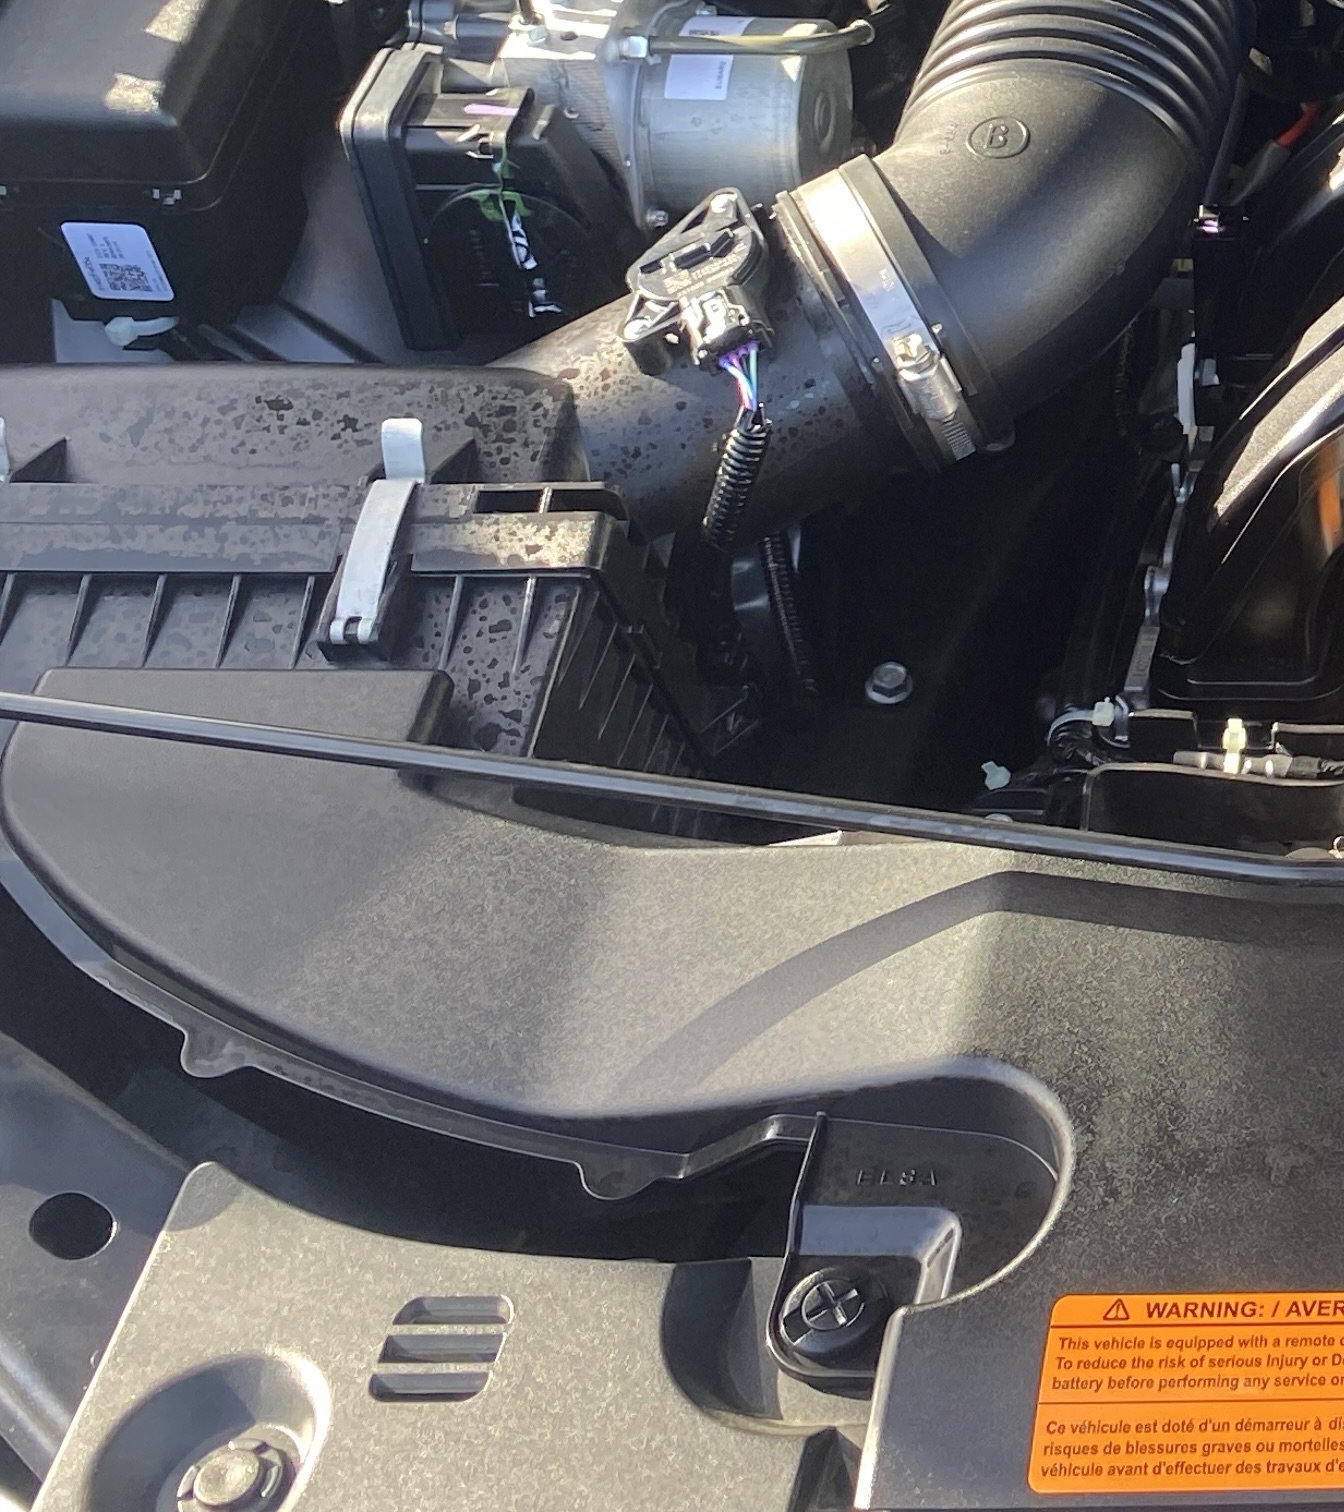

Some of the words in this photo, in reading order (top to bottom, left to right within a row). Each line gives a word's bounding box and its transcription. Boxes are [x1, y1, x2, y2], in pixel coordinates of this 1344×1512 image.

[1146, 1301, 1265, 1319] WARNING:
[1271, 1300, 1281, 1319] /
[1058, 1336, 1090, 1351] This
[1094, 1336, 1145, 1350] vehicle
[1149, 1336, 1162, 1349] is
[1166, 1335, 1234, 1352] equipped
[1238, 1335, 1268, 1348] with
[1272, 1337, 1281, 1348] a
[1284, 1336, 1337, 1347] remote
[1055, 1356, 1073, 1370] To
[1076, 1355, 1128, 1370] reduce
[1130, 1355, 1155, 1369] the
[1158, 1355, 1186, 1369] risk
[1189, 1354, 1205, 1368] of
[1207, 1354, 1262, 1368] serious
[1311, 1355, 1329, 1366] or
[1051, 1376, 1103, 1393] battery
[1107, 1375, 1154, 1389] before
[1157, 1374, 1240, 1392] performing
[1242, 1377, 1270, 1391] any
[1273, 1373, 1326, 1387] service
[1045, 1419, 1066, 1435] Ce
[1070, 1419, 1132, 1434] véhicule
[1134, 1420, 1158, 1433] est
[1161, 1418, 1194, 1433] doté
[1198, 1418, 1231, 1432] d'un
[1234, 1417, 1311, 1432] démarreur
[1313, 1416, 1323, 1430] à
[1042, 1441, 1099, 1458] risques
[1102, 1441, 1122, 1455] de
[1125, 1440, 1198, 1455] blessures
[1201, 1442, 1252, 1457] graves
[1255, 1442, 1275, 1453] ou
[1040, 1462, 1104, 1477] véhicule
[1106, 1463, 1149, 1477] avant
[1152, 1461, 1231, 1476] d'effectuer
[1235, 1460, 1262, 1474] des
[1265, 1460, 1321, 1474] travaux
